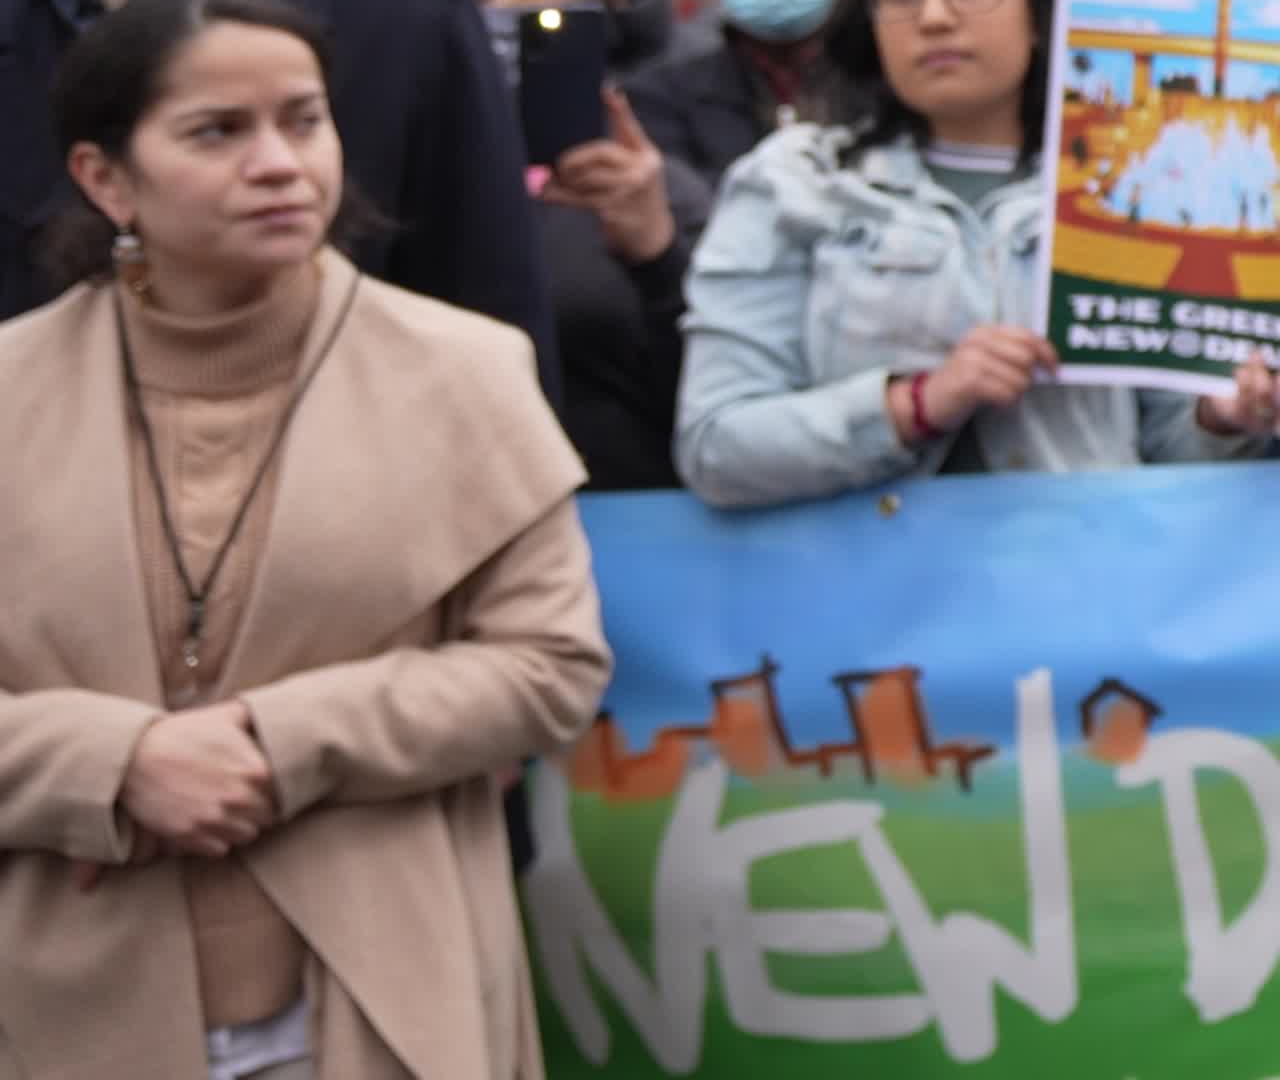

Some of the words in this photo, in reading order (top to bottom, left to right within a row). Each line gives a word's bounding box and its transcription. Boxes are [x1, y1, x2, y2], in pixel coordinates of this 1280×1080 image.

[1067, 293, 1162, 324] THE
[1066, 324, 1169, 354] NEW
[527, 668, 1078, 1075] NEW
